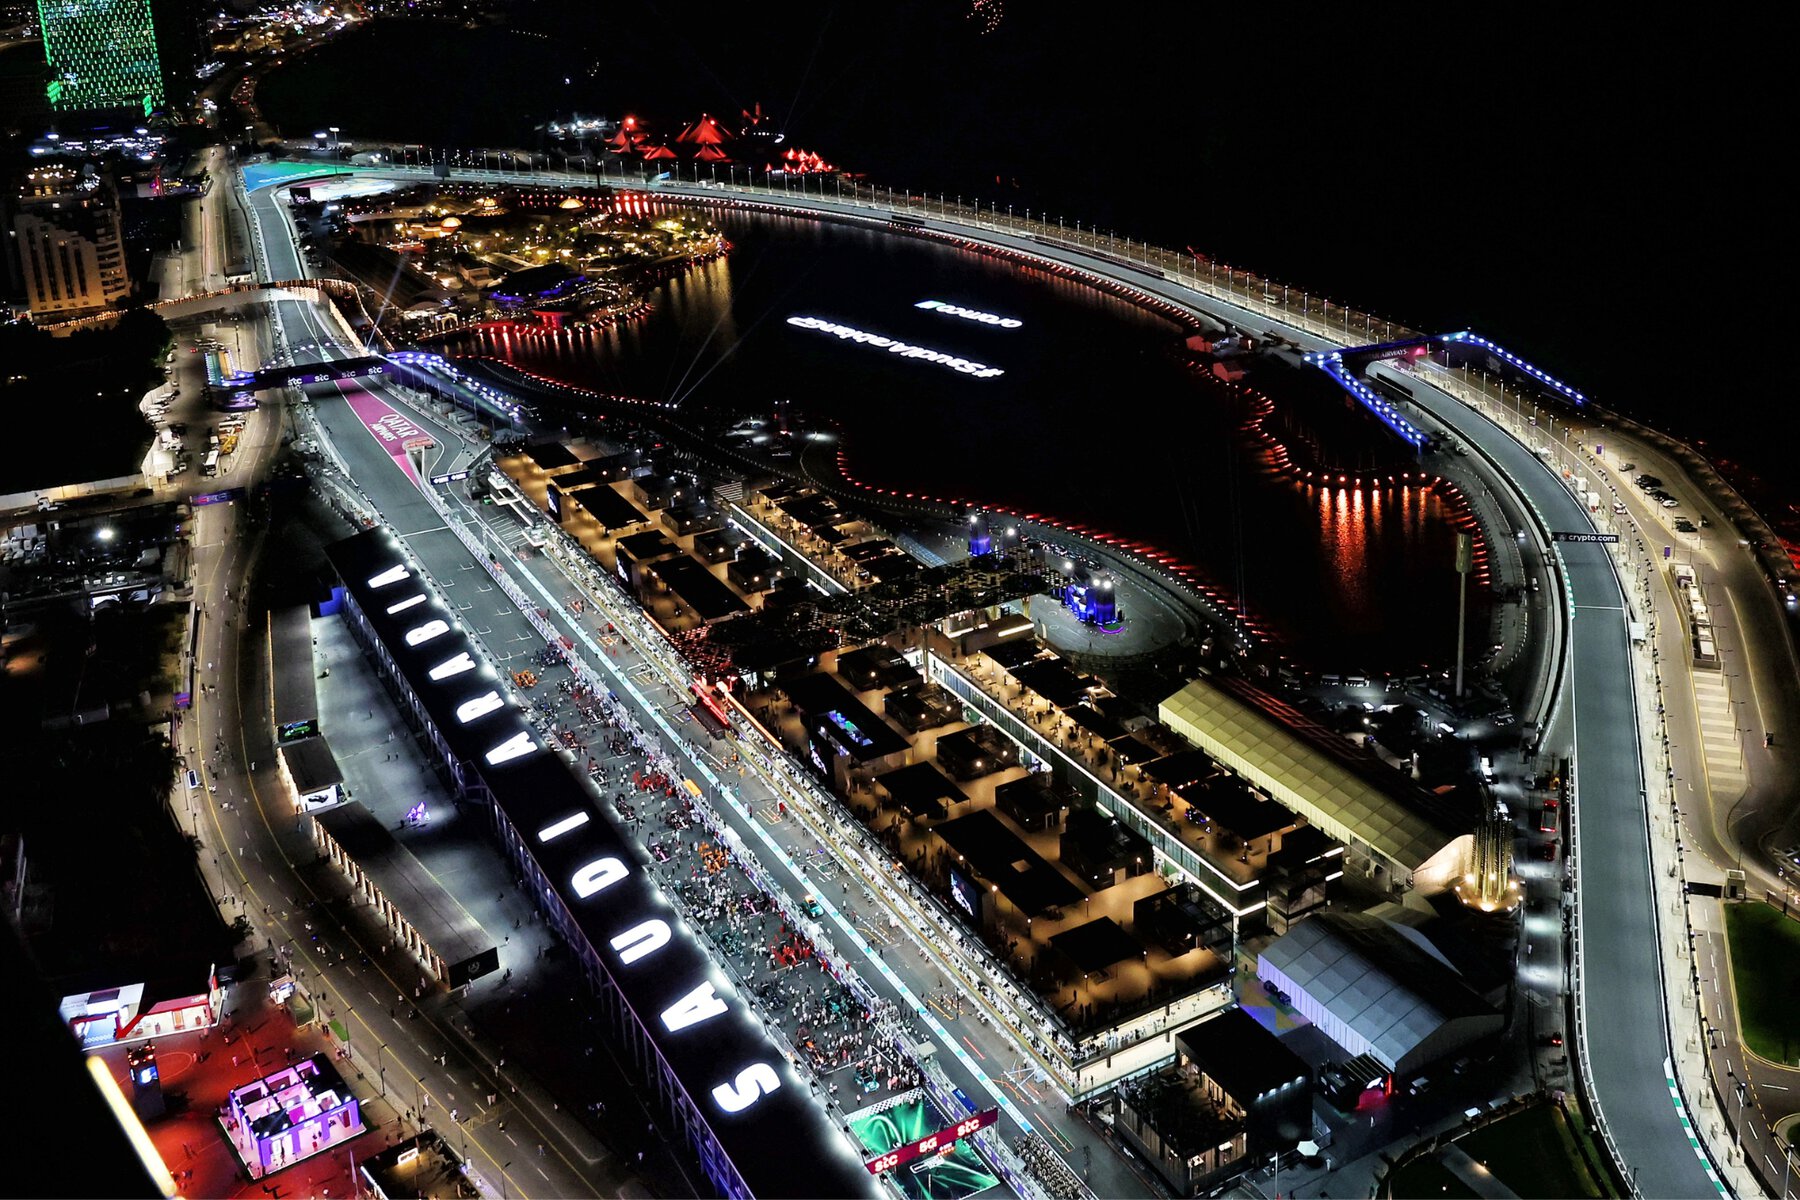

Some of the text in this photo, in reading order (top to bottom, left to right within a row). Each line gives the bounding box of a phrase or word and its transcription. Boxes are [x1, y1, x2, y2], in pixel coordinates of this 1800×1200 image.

[936, 304, 1023, 328] aramco
[314, 374, 330, 382] stc
[341, 371, 356, 379] stc
[367, 366, 383, 375] stc
[379, 414, 419, 438] QATAR
[1568, 534, 1616, 542] crypto.com
[368, 564, 538, 765] ARABIA
[538, 811, 781, 1112] SAUDI
[874, 1153, 898, 1173] stc
[919, 1136, 937, 1153] 5G
[957, 1117, 980, 1137] stc
